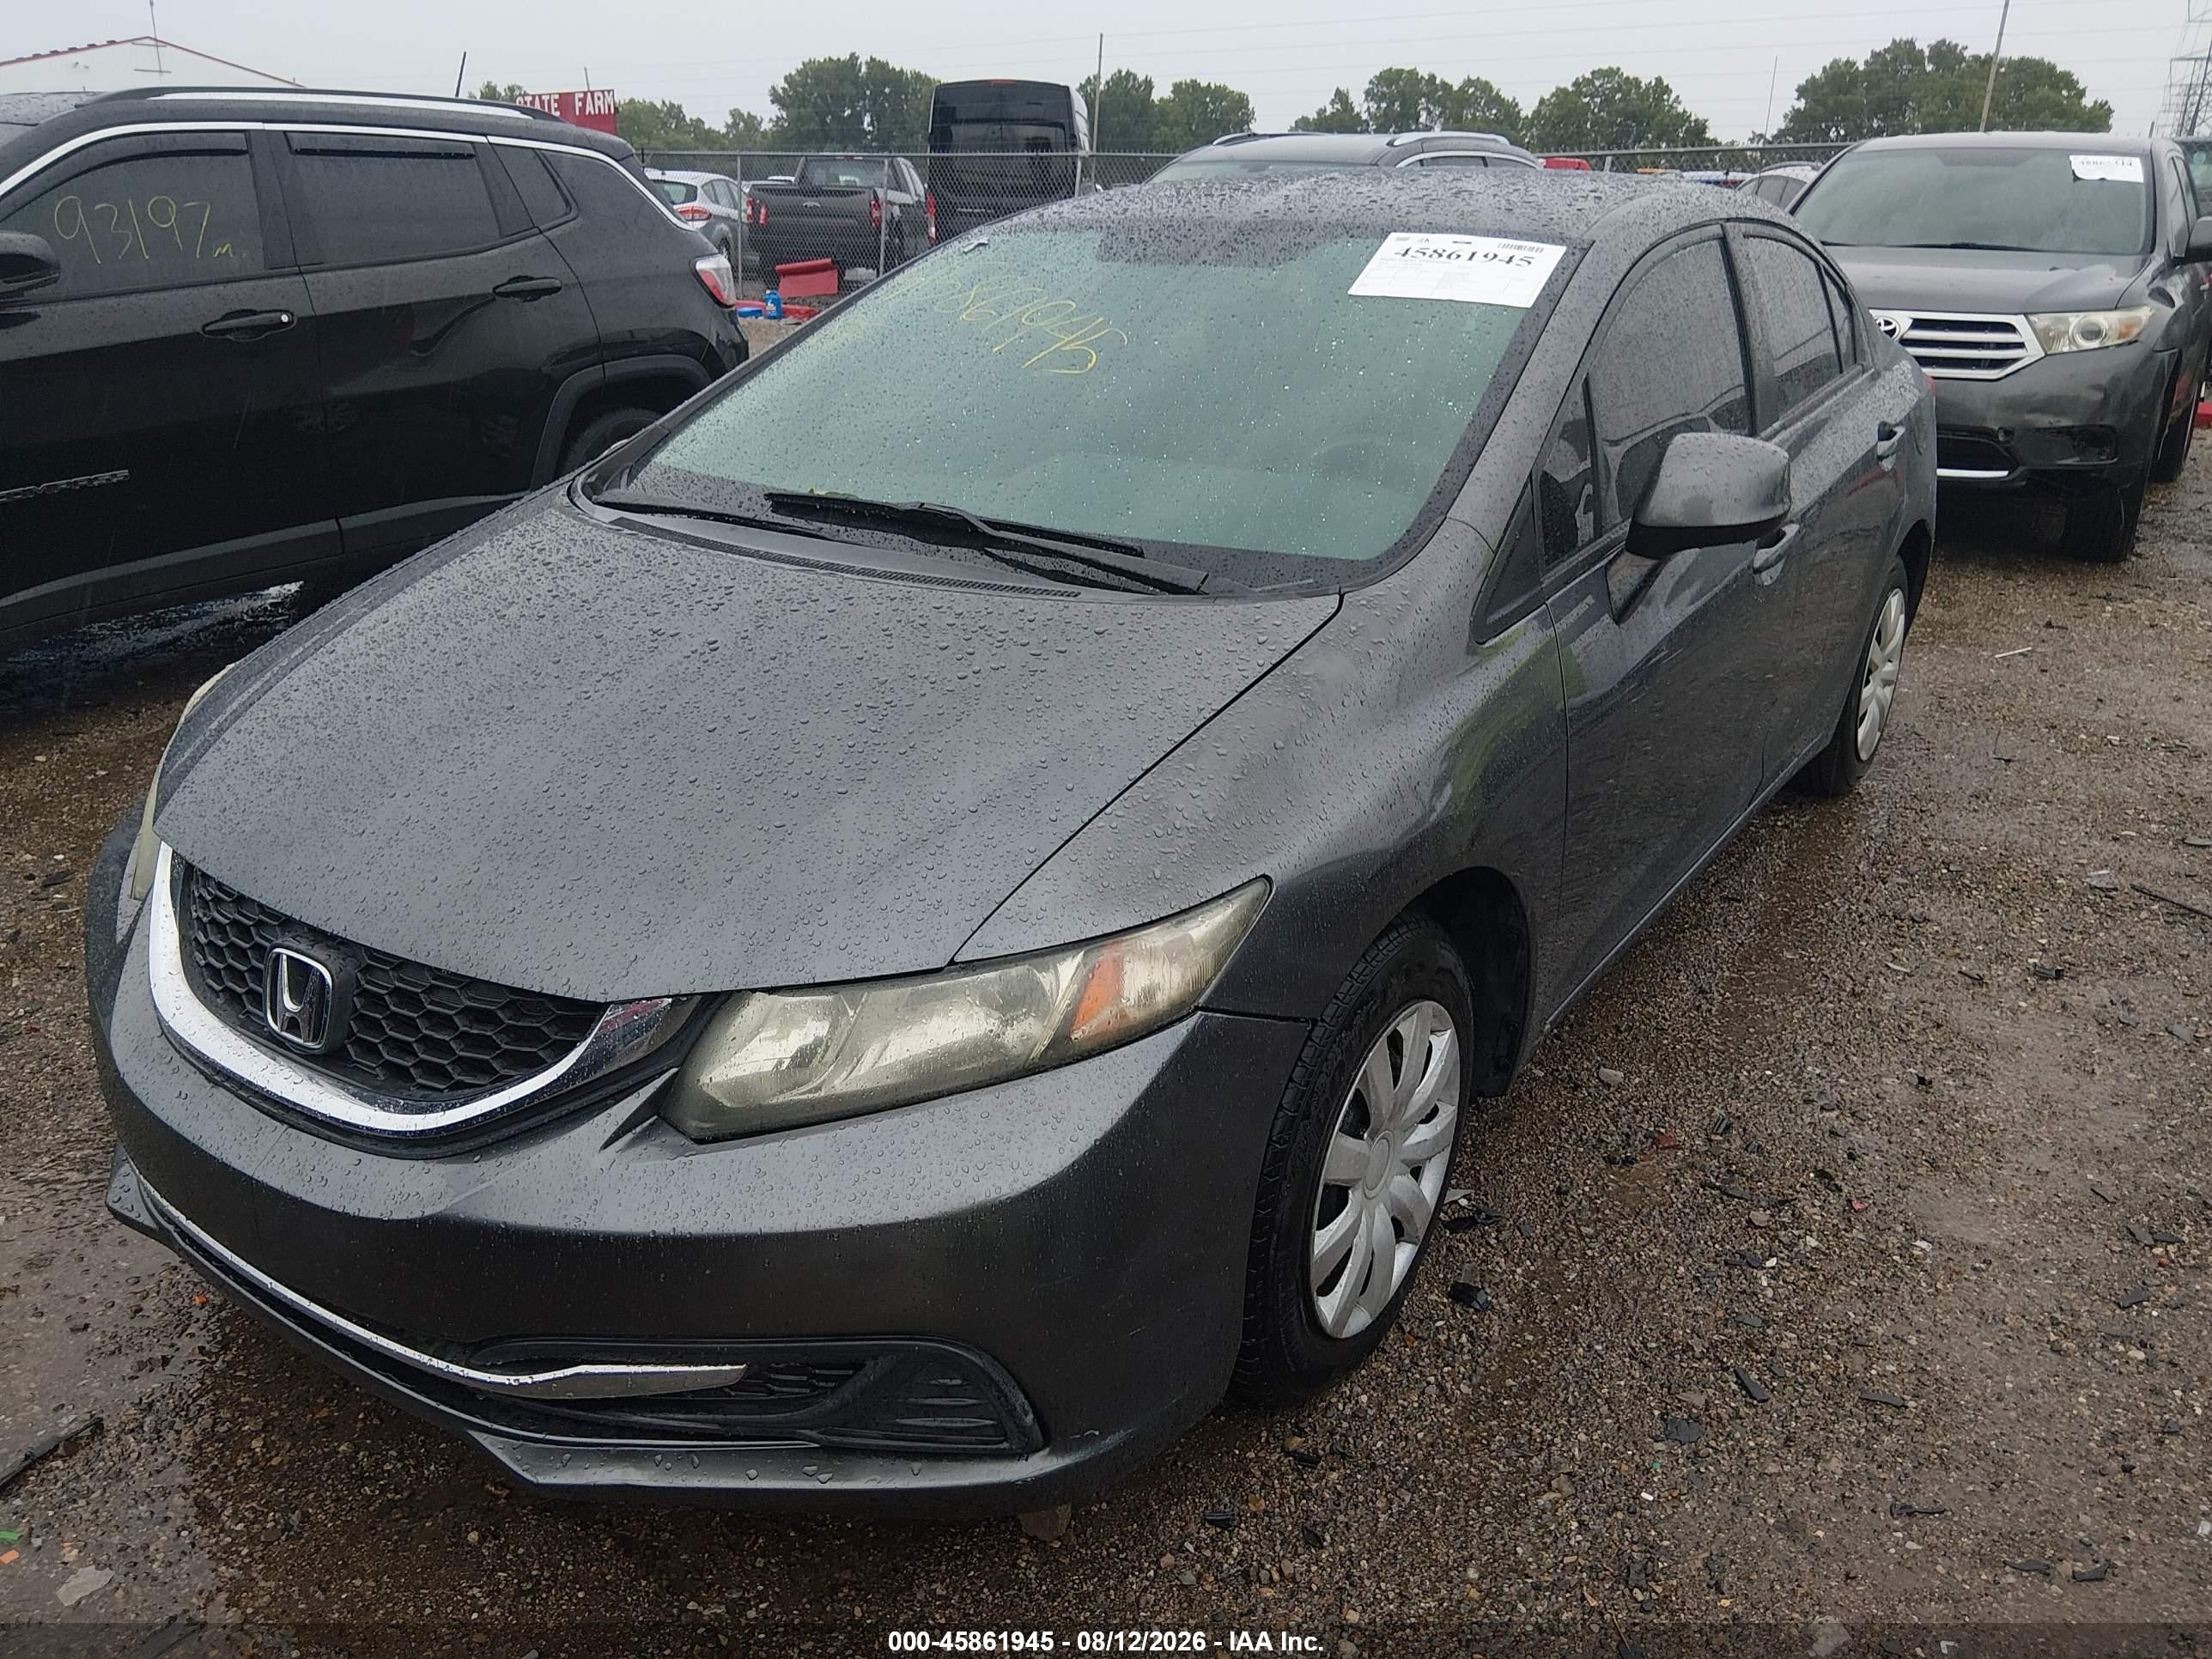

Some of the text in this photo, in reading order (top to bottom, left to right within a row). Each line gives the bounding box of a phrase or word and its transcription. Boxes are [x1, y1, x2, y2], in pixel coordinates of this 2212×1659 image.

[574, 91, 616, 116] FARM
[54, 196, 211, 264] 93197
[1395, 246, 1535, 267] 45861945
